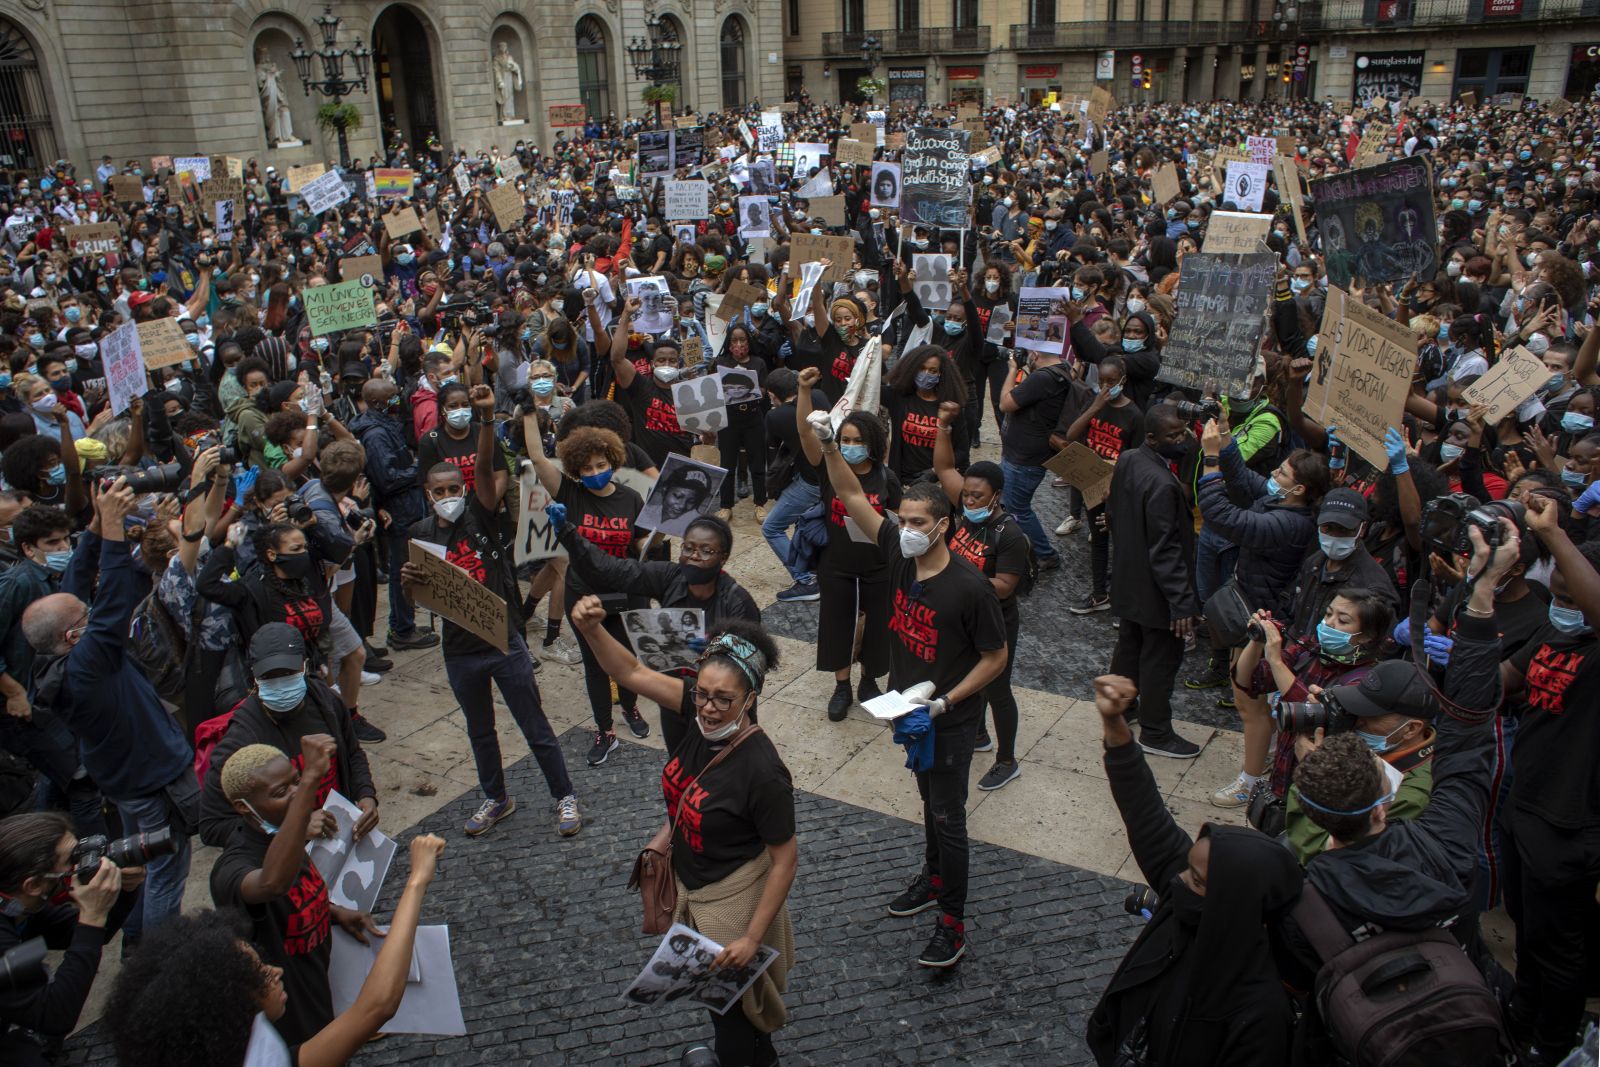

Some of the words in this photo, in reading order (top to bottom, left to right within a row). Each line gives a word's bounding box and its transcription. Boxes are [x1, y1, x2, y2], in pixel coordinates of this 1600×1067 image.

[1370, 56, 1407, 68] sunglass
[1407, 55, 1422, 65] hut
[757, 125, 777, 136] BLACK
[1248, 138, 1274, 148] BLACK
[1252, 148, 1274, 156] LIVES
[926, 155, 938, 168] in
[938, 160, 970, 178] gangs
[919, 169, 939, 184] with
[75, 239, 119, 254] CRIME
[306, 293, 325, 305] MI
[330, 288, 366, 301] ÚNICO
[310, 301, 355, 318] CRIMEN
[357, 297, 369, 308] ES
[316, 315, 338, 328] SER
[341, 308, 375, 324] NEGRA
[1321, 313, 1344, 344] LAS
[1346, 322, 1376, 357] VIDAS
[1375, 339, 1412, 379] NEGRAS
[1505, 351, 1519, 364] NO
[1334, 353, 1389, 402] IMPORTAN
[1467, 387, 1478, 398] NO
[1090, 417, 1122, 438] BLACK
[902, 435, 936, 449] MATTE
[583, 513, 629, 530] BLACK
[955, 527, 990, 557] BLACK
[895, 588, 937, 627] BLACK
[1535, 642, 1585, 673] BLACK
[663, 757, 710, 809] BLACK
